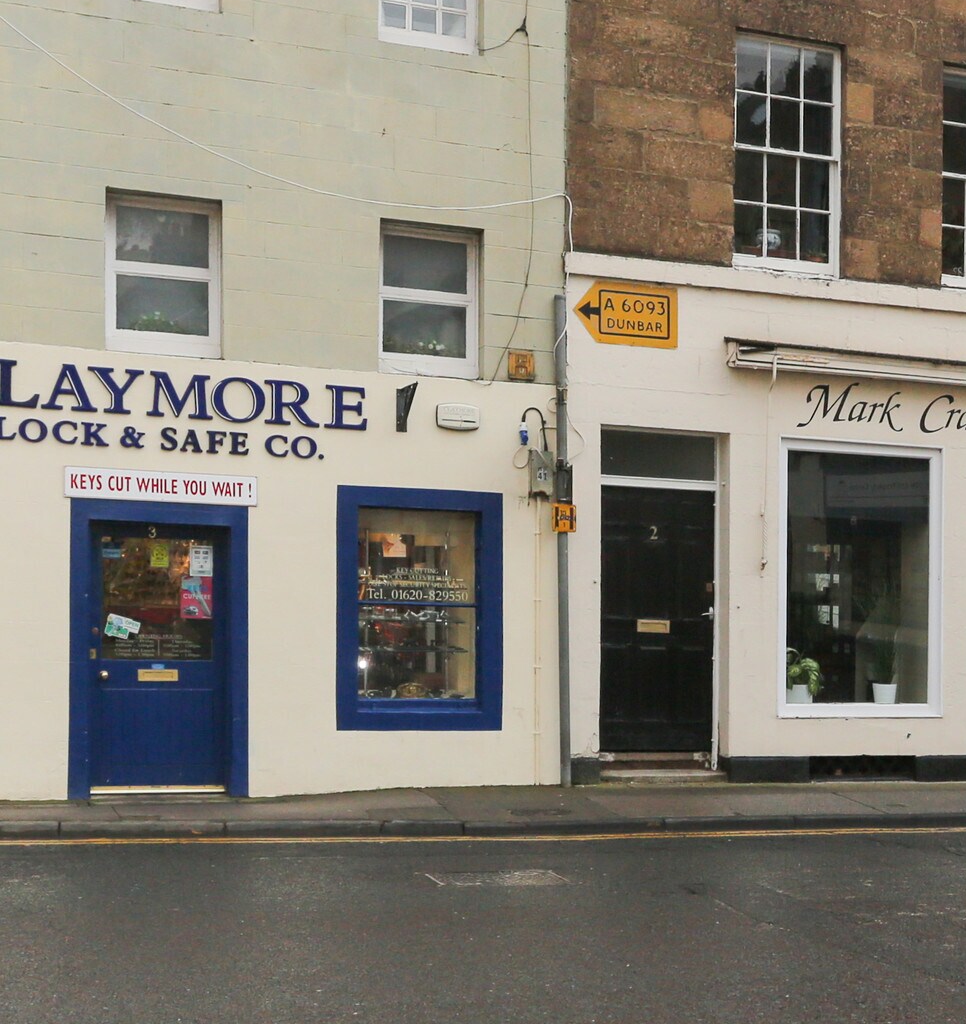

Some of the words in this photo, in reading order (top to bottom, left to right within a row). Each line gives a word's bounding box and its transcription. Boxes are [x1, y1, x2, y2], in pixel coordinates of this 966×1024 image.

[604, 298, 614, 311] A
[622, 298, 666, 316] 6093
[607, 318, 662, 332] DUNBAR
[0, 358, 368, 431] LAYMORE
[796, 382, 903, 432] Mark
[0, 416, 109, 447] LOCK
[120, 426, 146, 449] &
[160, 426, 250, 456] SAFE
[264, 434, 324, 460] CO.
[70, 474, 102, 490] KEYS
[108, 476, 132, 492] CUT
[136, 477, 178, 494] WHILE
[183, 480, 207, 496] YOU
[212, 482, 244, 497] WAIT
[248, 483, 252, 498] !
[148, 526, 156, 538] 3
[650, 526, 658, 540] 2
[366, 588, 386, 599] Tel.
[392, 590, 468, 601] 01620-829550
